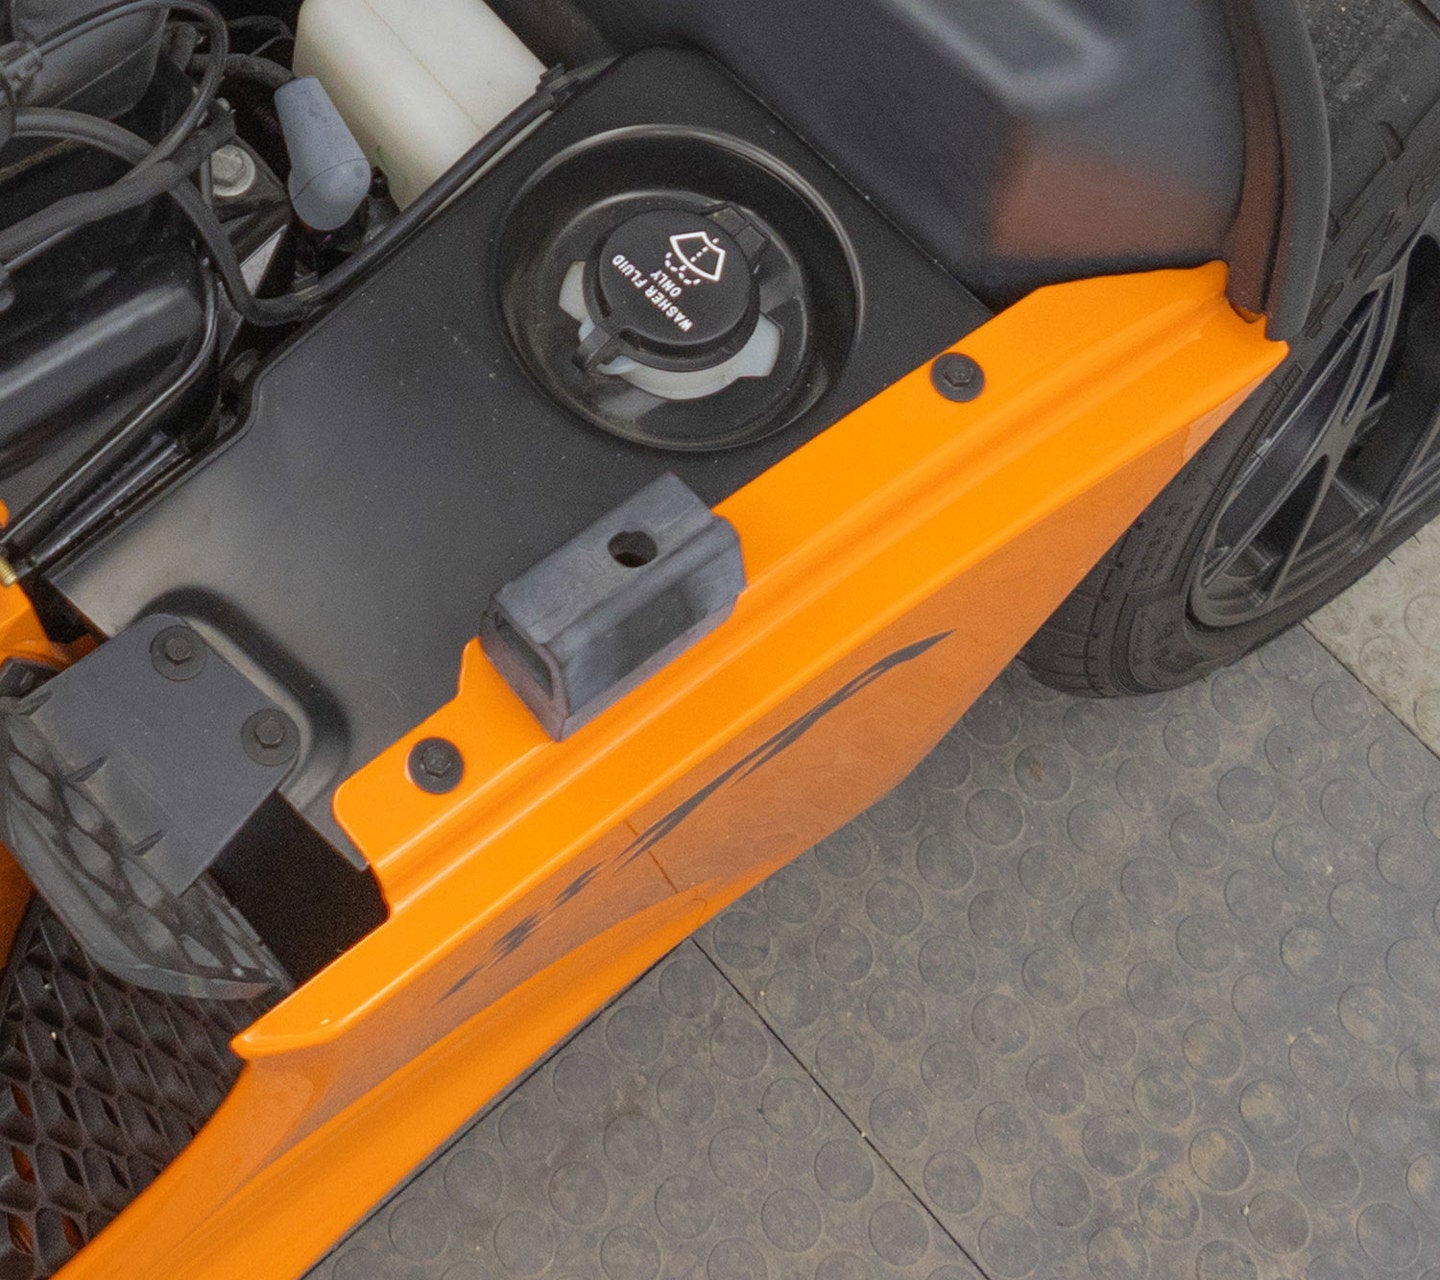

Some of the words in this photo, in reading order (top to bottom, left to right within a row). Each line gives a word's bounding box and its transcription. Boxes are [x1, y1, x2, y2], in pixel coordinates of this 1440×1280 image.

[612, 254, 648, 288] FLUID
[649, 269, 682, 298] ONLY
[644, 284, 693, 332] WASHER
